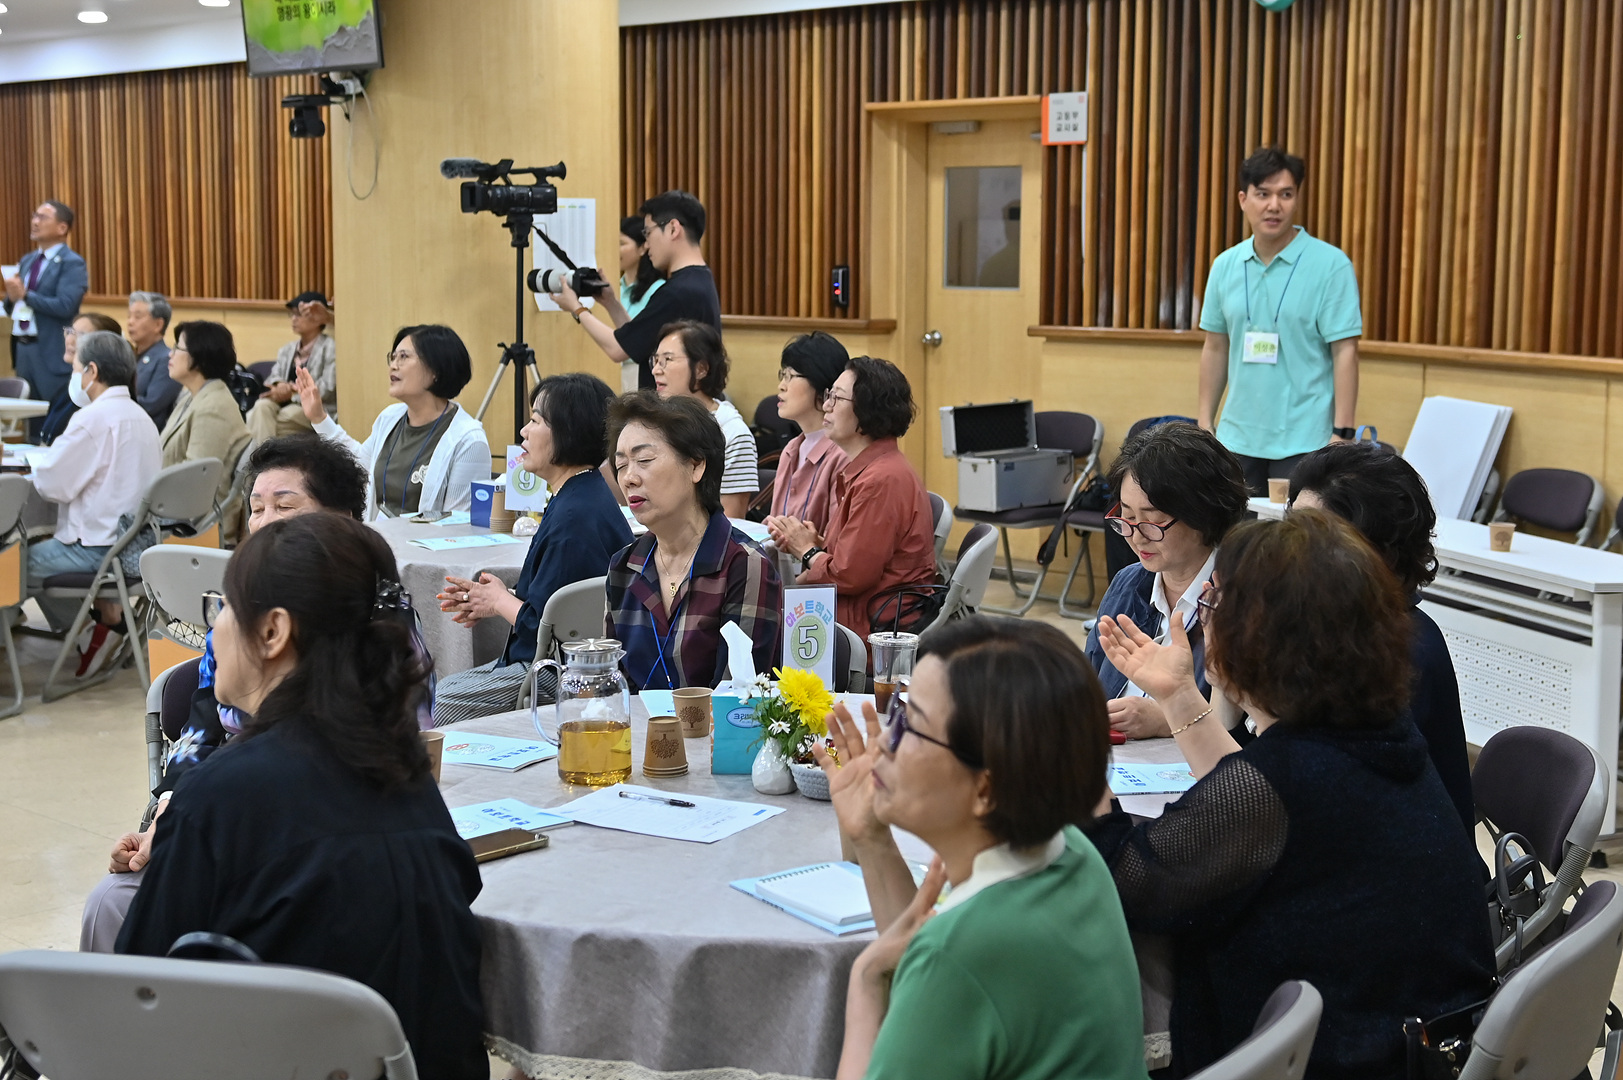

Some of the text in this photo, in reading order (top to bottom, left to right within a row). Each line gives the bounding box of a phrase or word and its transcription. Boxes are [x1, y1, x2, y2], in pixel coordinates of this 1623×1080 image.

[518, 468, 537, 491] 9
[785, 600, 833, 628] 아보트학교
[798, 624, 819, 660] 5
